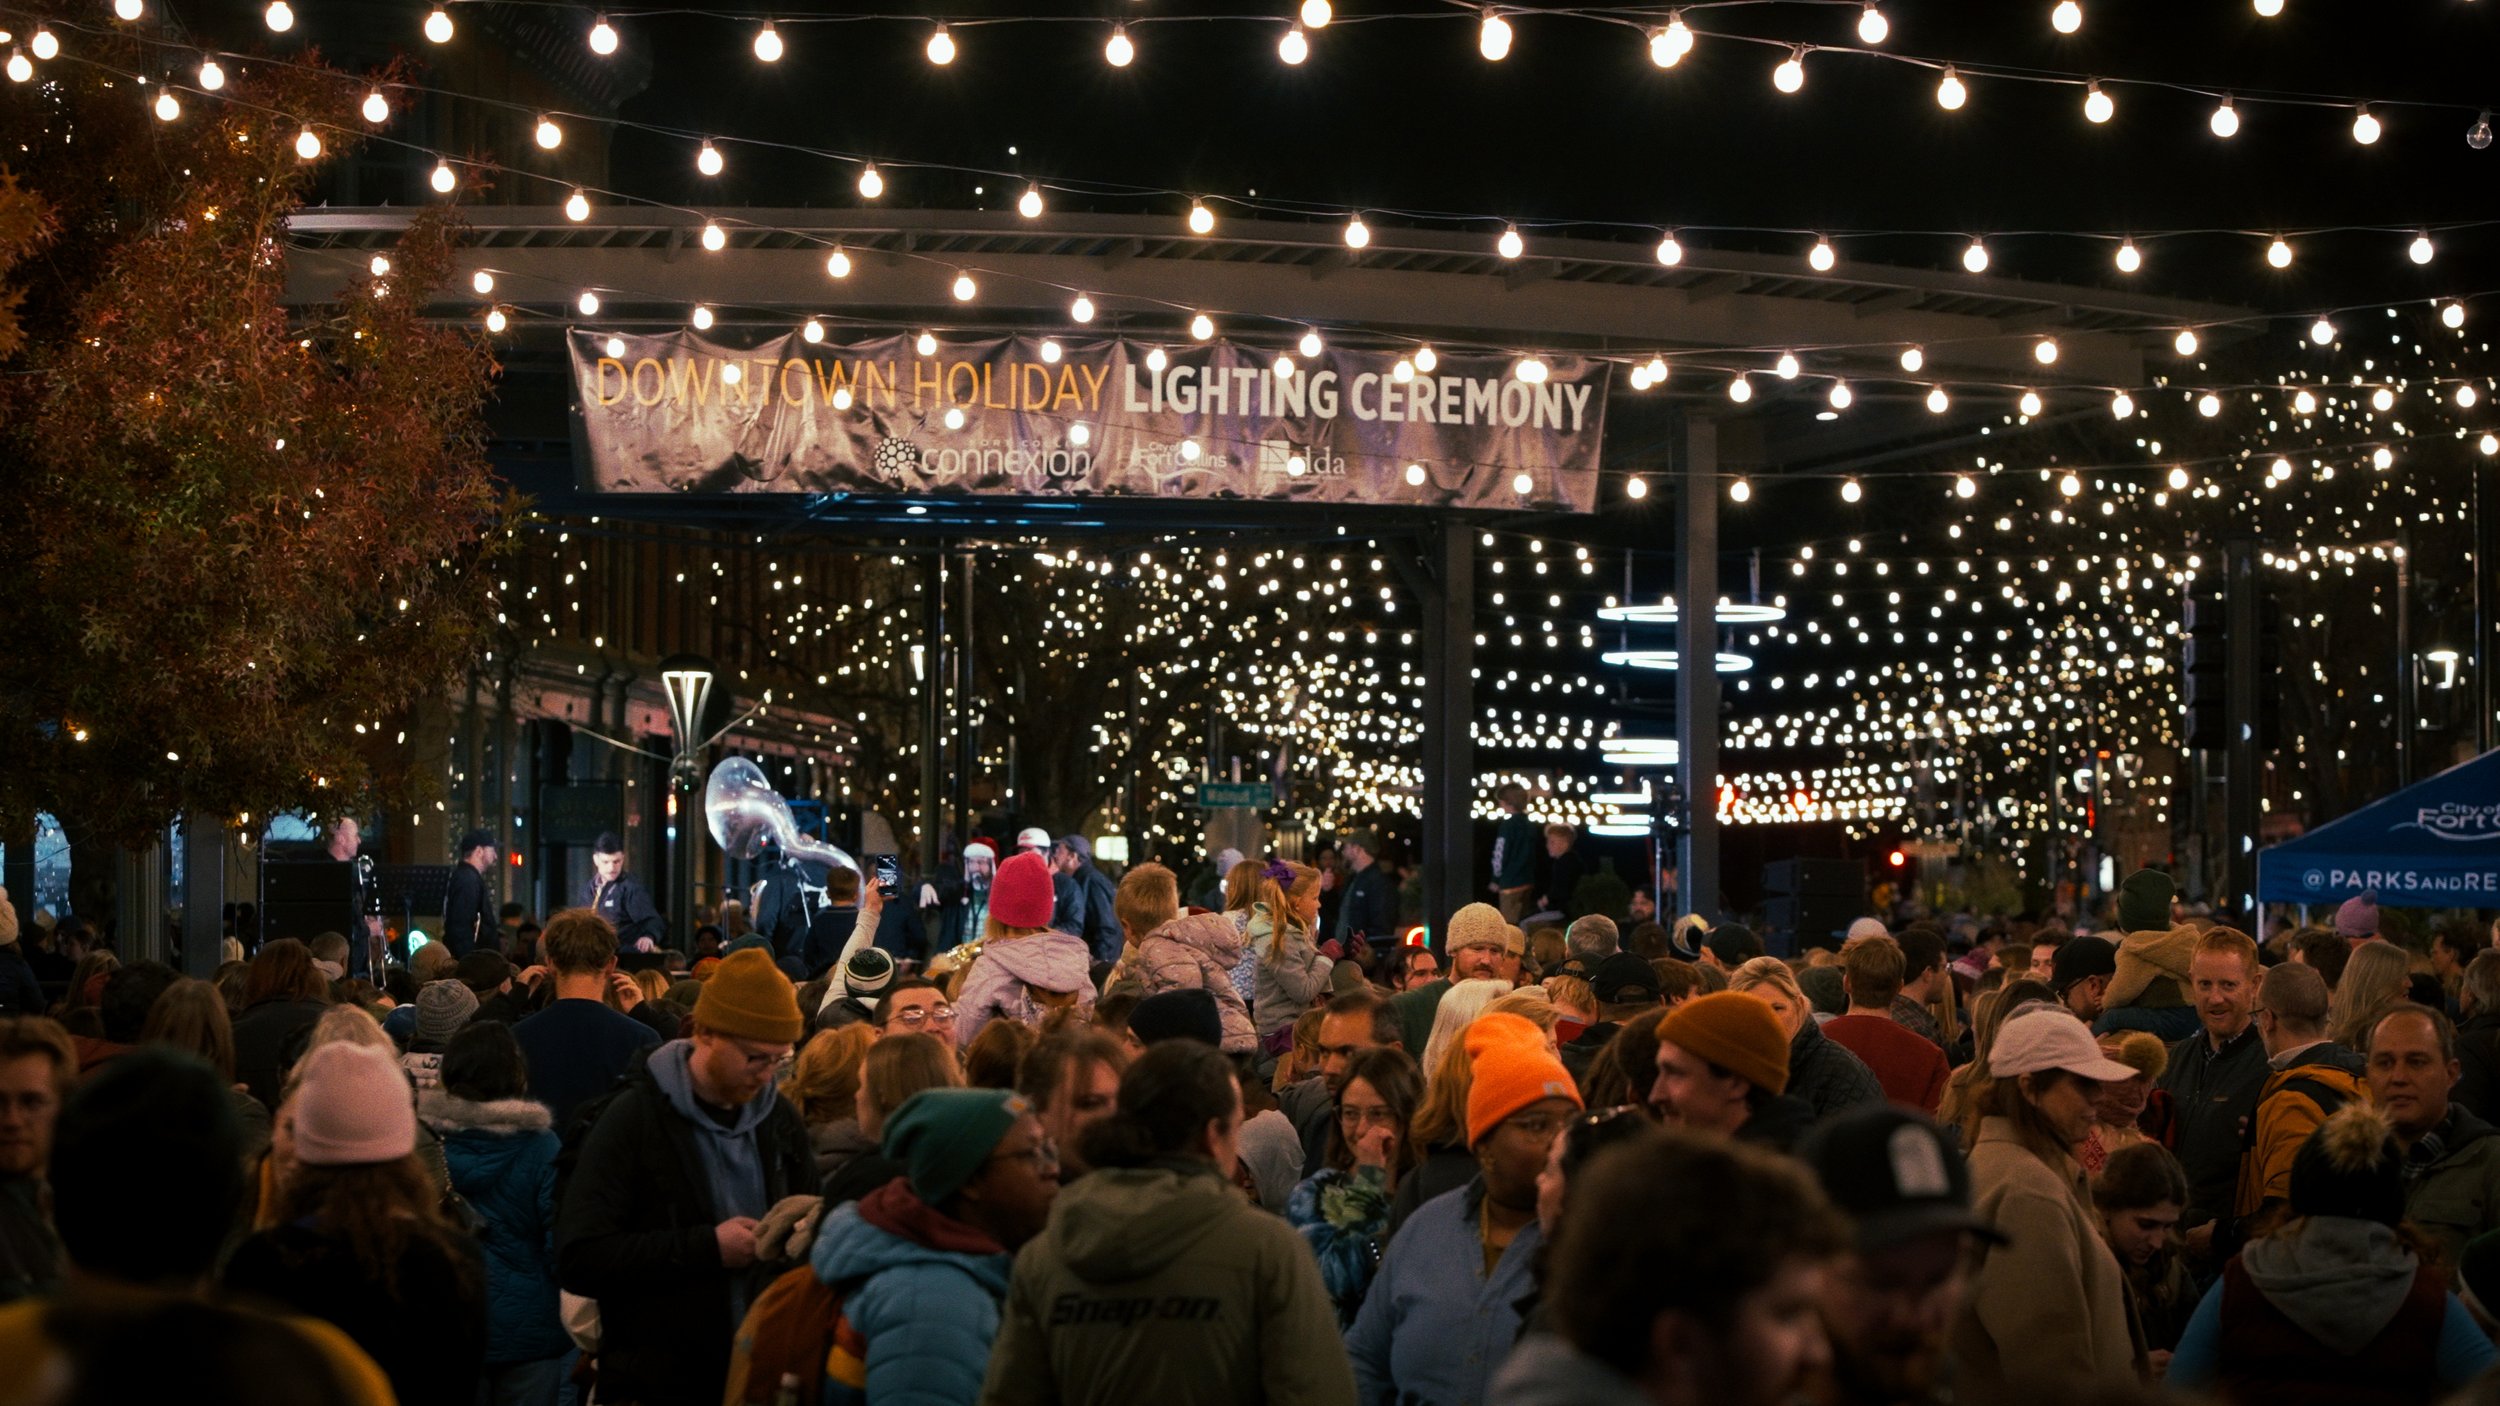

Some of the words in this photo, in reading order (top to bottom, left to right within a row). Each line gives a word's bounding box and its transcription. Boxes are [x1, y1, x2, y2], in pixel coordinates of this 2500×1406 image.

[597, 357, 896, 406] DOWNTOWN
[914, 360, 1110, 412] HOLIDAY
[1124, 364, 1339, 419] LIGHTING
[1351, 371, 1593, 432] CEREMONY
[921, 447, 1090, 477] connexion
[1139, 448, 1173, 466] Fort
[2417, 808, 2486, 829] Fort
[2441, 802, 2479, 815] City
